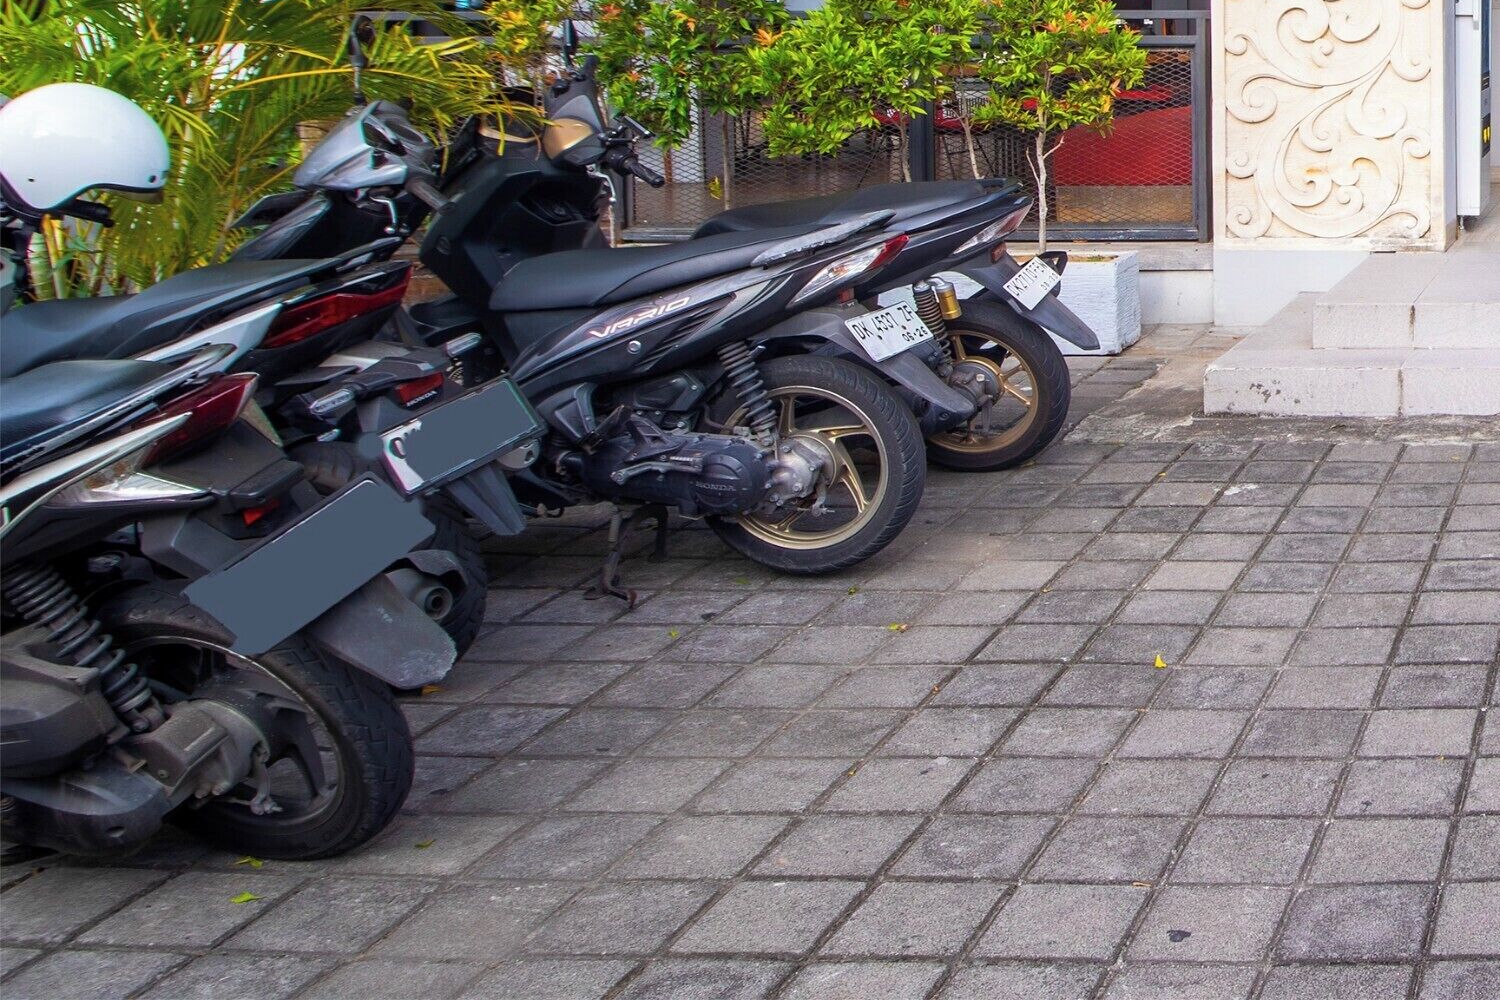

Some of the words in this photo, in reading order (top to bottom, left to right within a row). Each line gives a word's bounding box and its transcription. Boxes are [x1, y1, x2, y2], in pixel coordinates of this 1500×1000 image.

[589, 296, 690, 338] VARIO
[851, 321, 874, 340] DK
[871, 312, 899, 334] 4537
[897, 304, 915, 322] ZF
[406, 390, 437, 407] HONDA
[696, 481, 737, 491] HONDA
